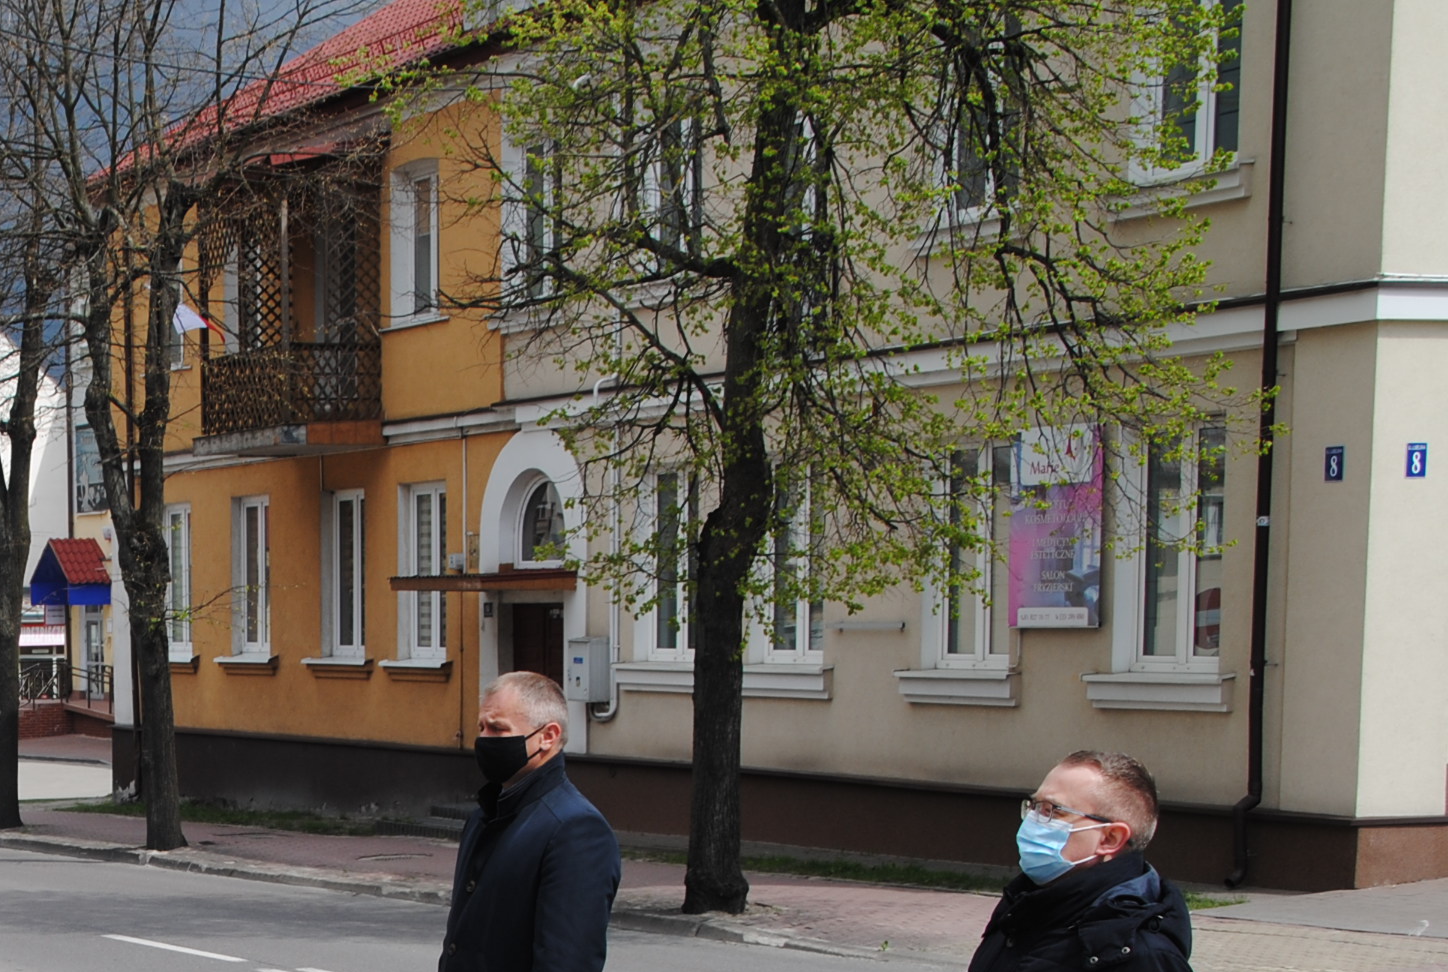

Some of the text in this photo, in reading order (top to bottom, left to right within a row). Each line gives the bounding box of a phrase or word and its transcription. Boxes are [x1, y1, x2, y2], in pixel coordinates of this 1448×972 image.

[1330, 455, 1338, 477] 8
[1413, 451, 1421, 474] 8
[1037, 537, 1073, 548] MEDYCYN
[1041, 570, 1065, 580] SALON
[1033, 582, 1074, 593] FRYZJERSKI
